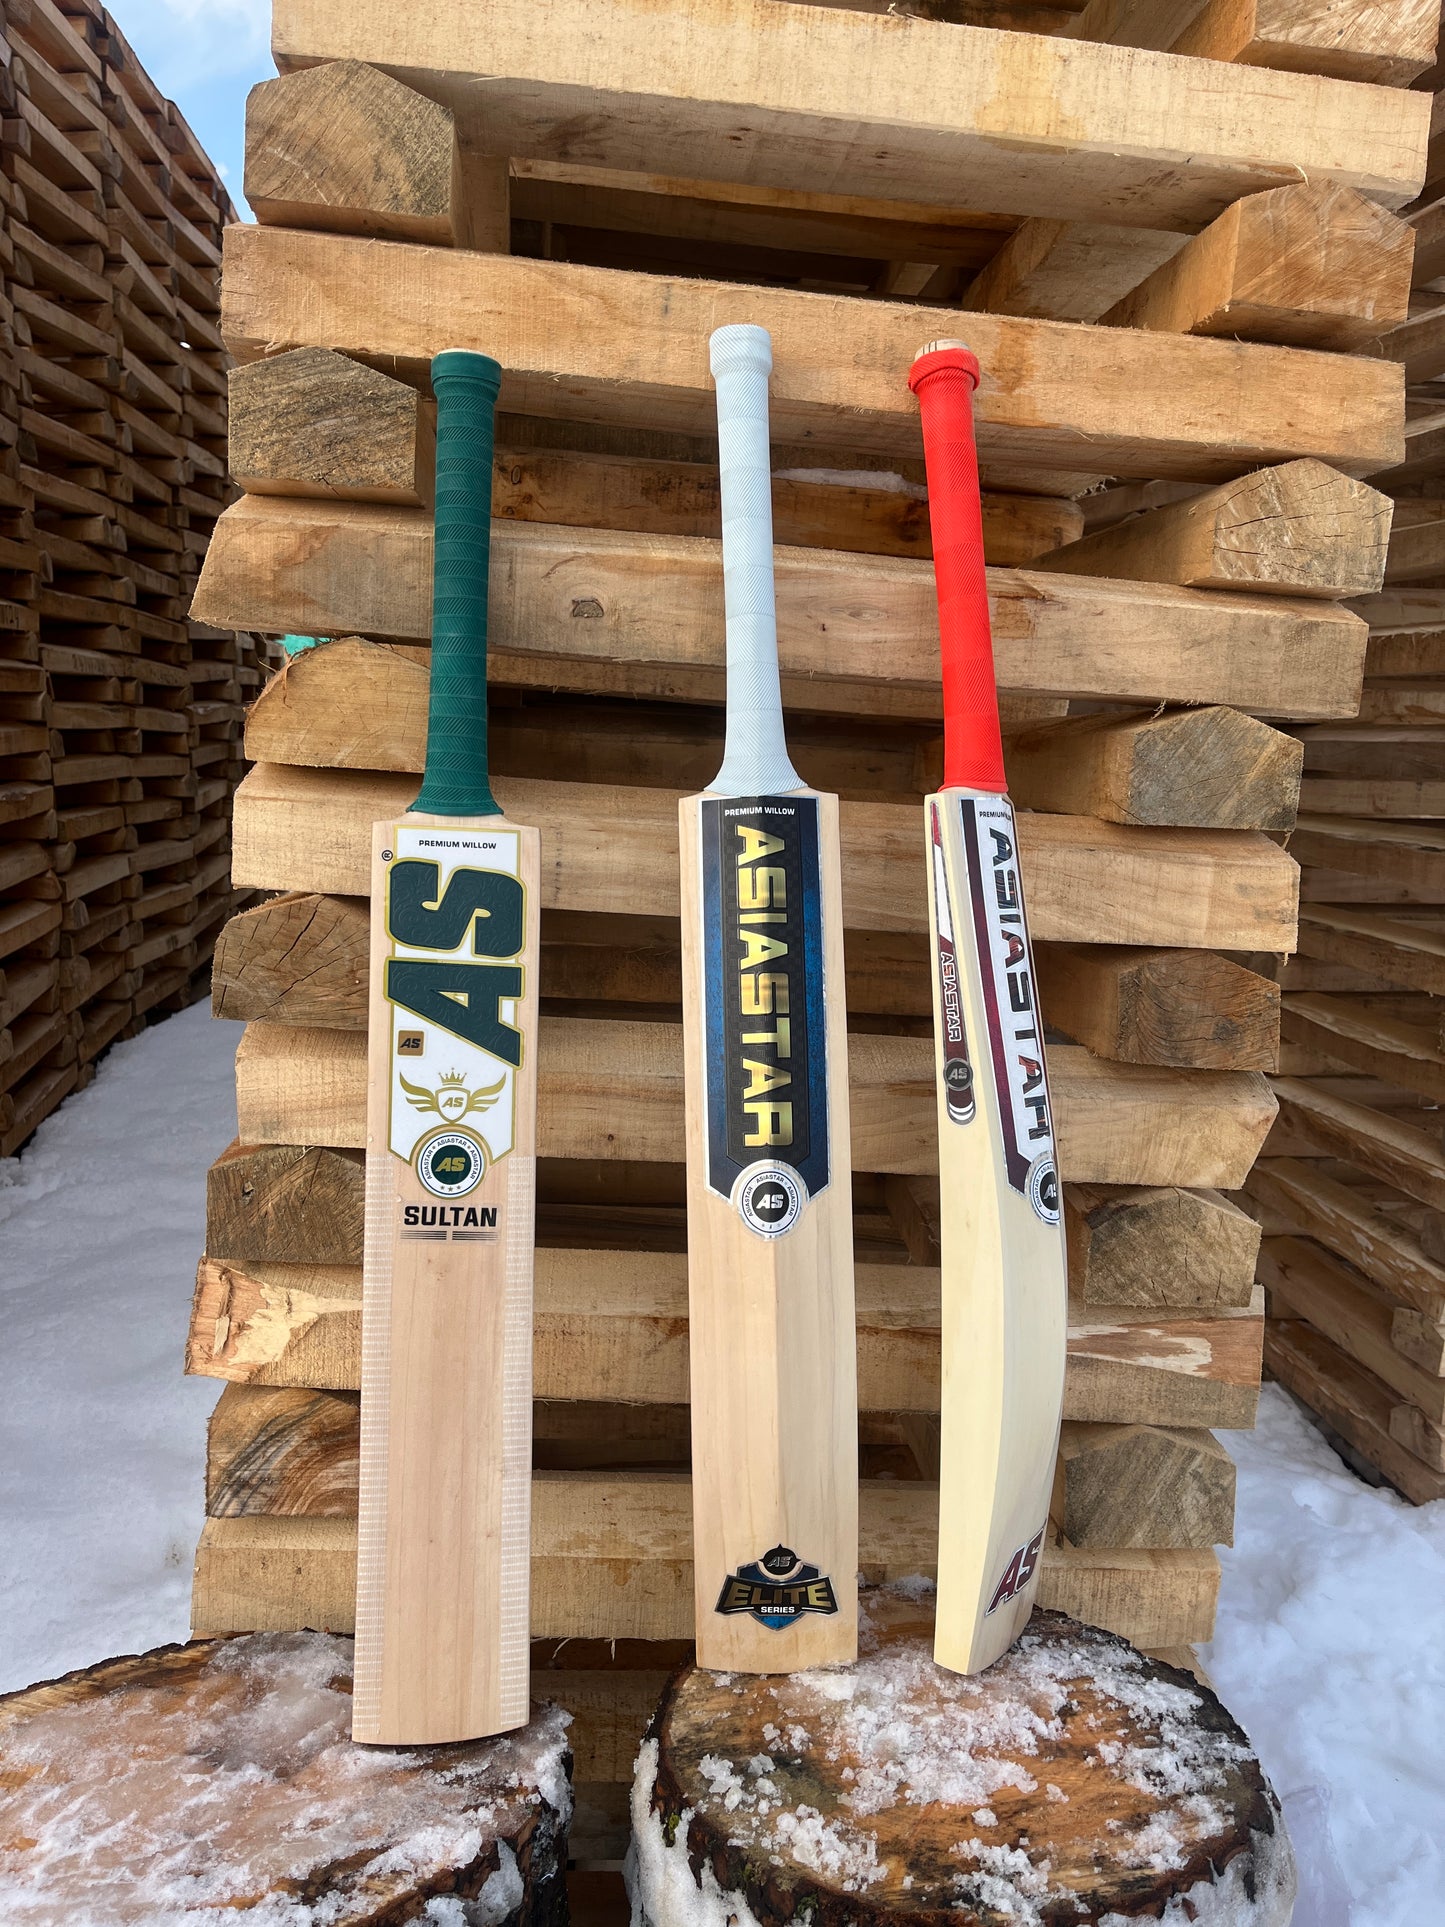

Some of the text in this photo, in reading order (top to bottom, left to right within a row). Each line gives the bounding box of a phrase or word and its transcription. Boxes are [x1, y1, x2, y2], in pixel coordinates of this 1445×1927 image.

[724, 806, 795, 816] PREMIUM WILLOW
[418, 839, 497, 850] PREMIUM WILLOW
[386, 858, 525, 1068] AS
[736, 824, 793, 1147] ASIASTAR
[941, 951, 962, 1042] ASIASTAR
[400, 1037, 421, 1049] AS
[948, 1066, 968, 1080] AS
[441, 1096, 465, 1108] AS
[436, 1138, 468, 1148] ASIASTAR
[423, 1149, 434, 1180] ASIASTAR
[434, 1156, 466, 1172] AS
[469, 1149, 479, 1181] ASIASTAR
[756, 1174, 785, 1183] ASIASTAR
[755, 1193, 784, 1209] AS
[403, 1205, 498, 1227] SULTAN
[766, 1555, 793, 1568] AS
[985, 1523, 1046, 1616] AS
[723, 1581, 832, 1608] ELITE
[760, 1606, 796, 1614] SERIES
